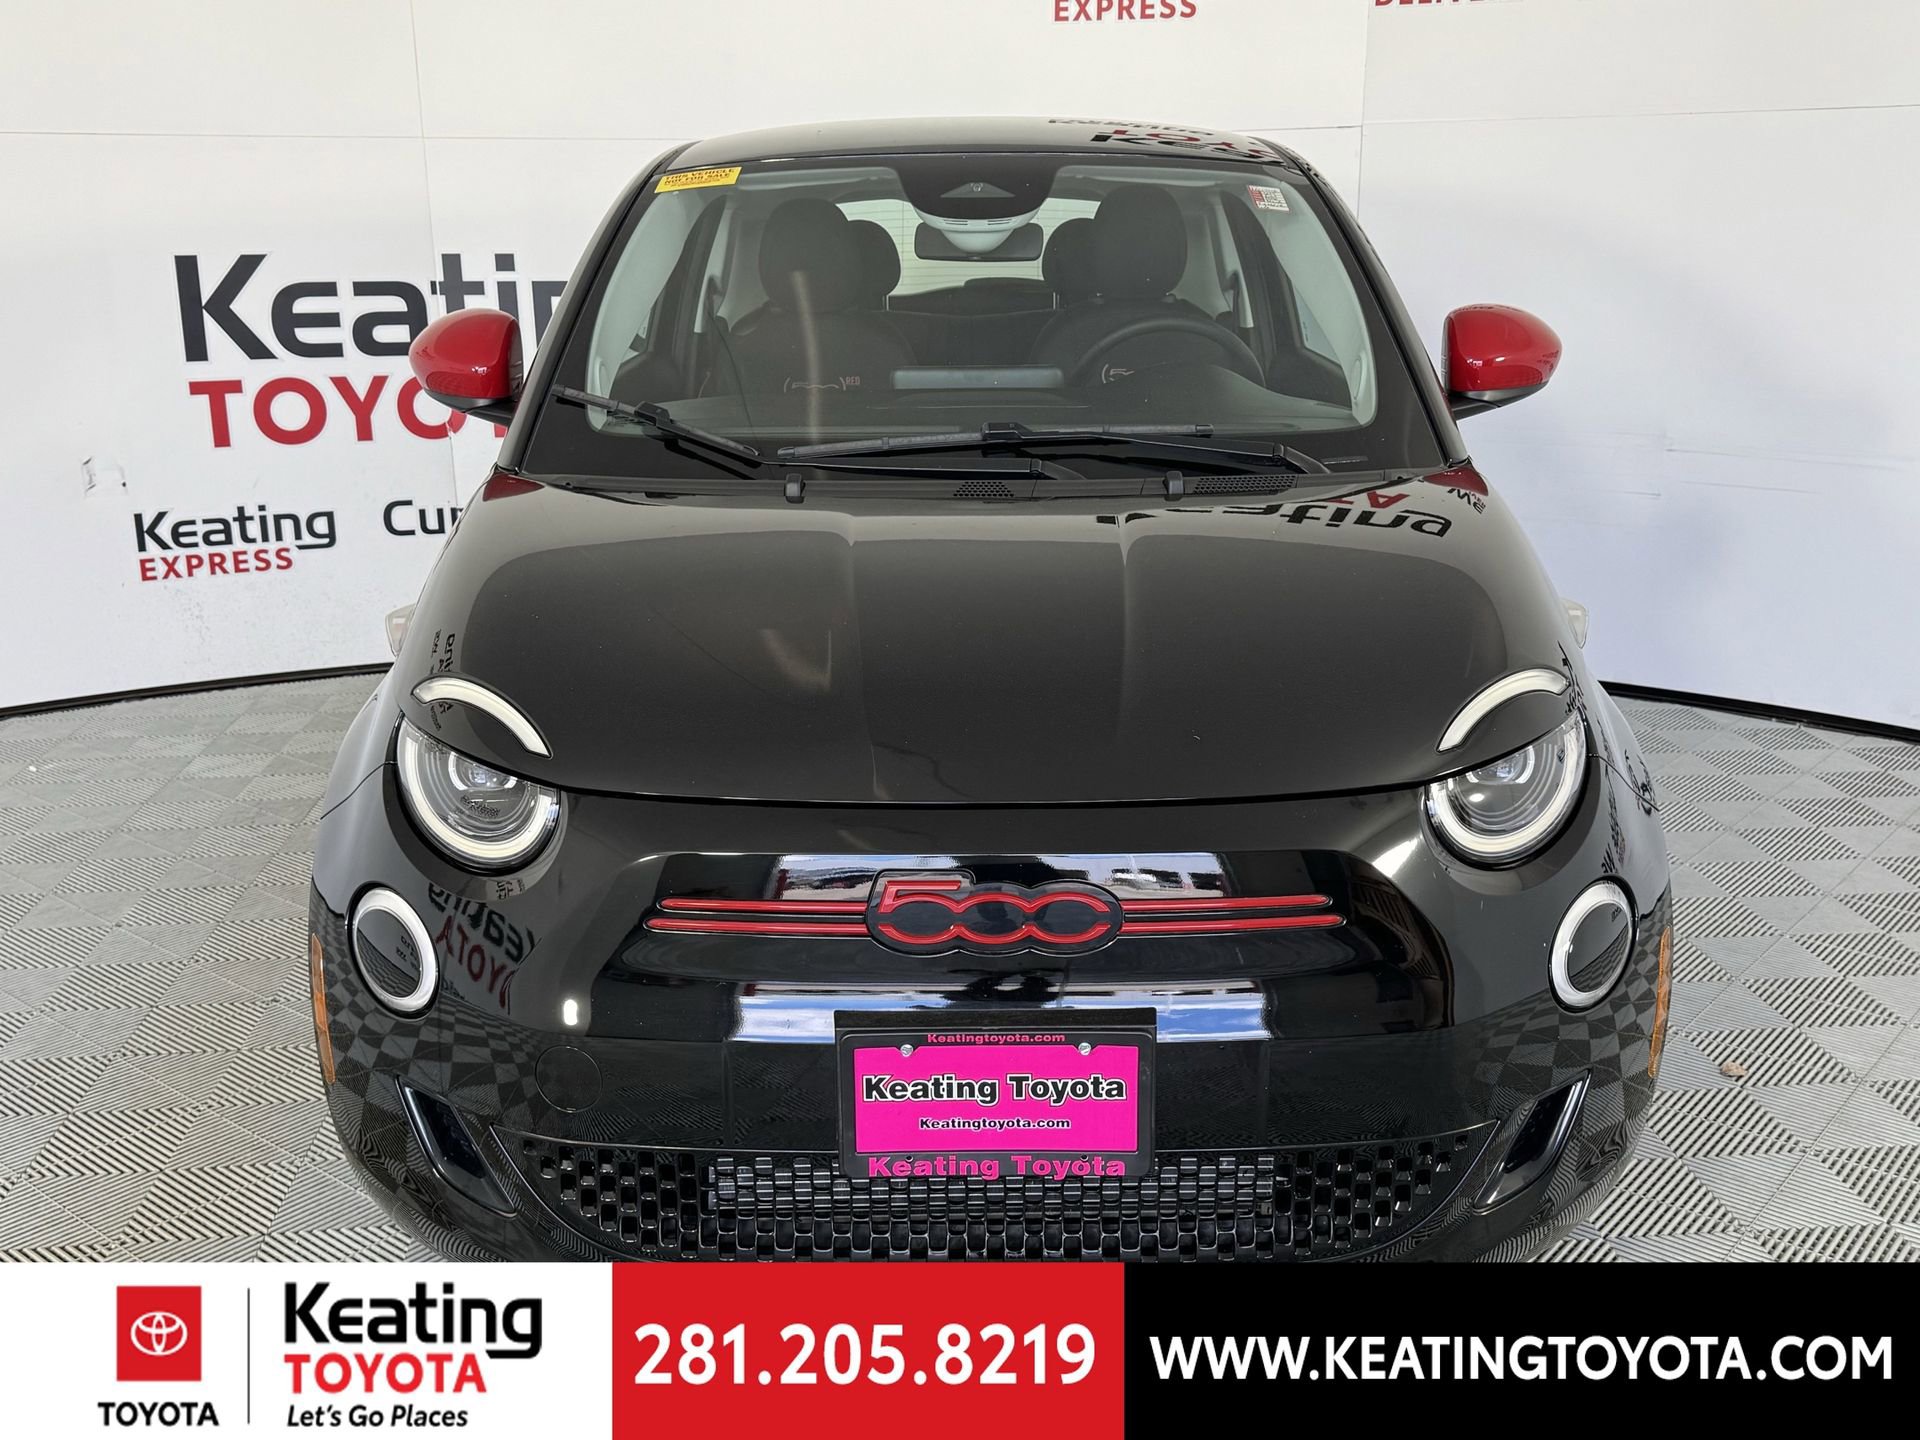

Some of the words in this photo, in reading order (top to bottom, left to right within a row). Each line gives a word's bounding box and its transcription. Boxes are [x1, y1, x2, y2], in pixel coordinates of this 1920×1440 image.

[1054, 0, 1197, 21] EXPRESS
[134, 504, 337, 552] Keating
[140, 547, 294, 581] EXPRESS
[878, 879, 1112, 944] 500
[927, 1033, 1065, 1045] Keatingtoyota.com
[863, 1074, 999, 1105] Keating
[1006, 1074, 1127, 1106] Toyota
[919, 1117, 1071, 1132] Keatingtoyota.com
[868, 1155, 999, 1180] Keating
[1010, 1155, 1126, 1181] Toyota
